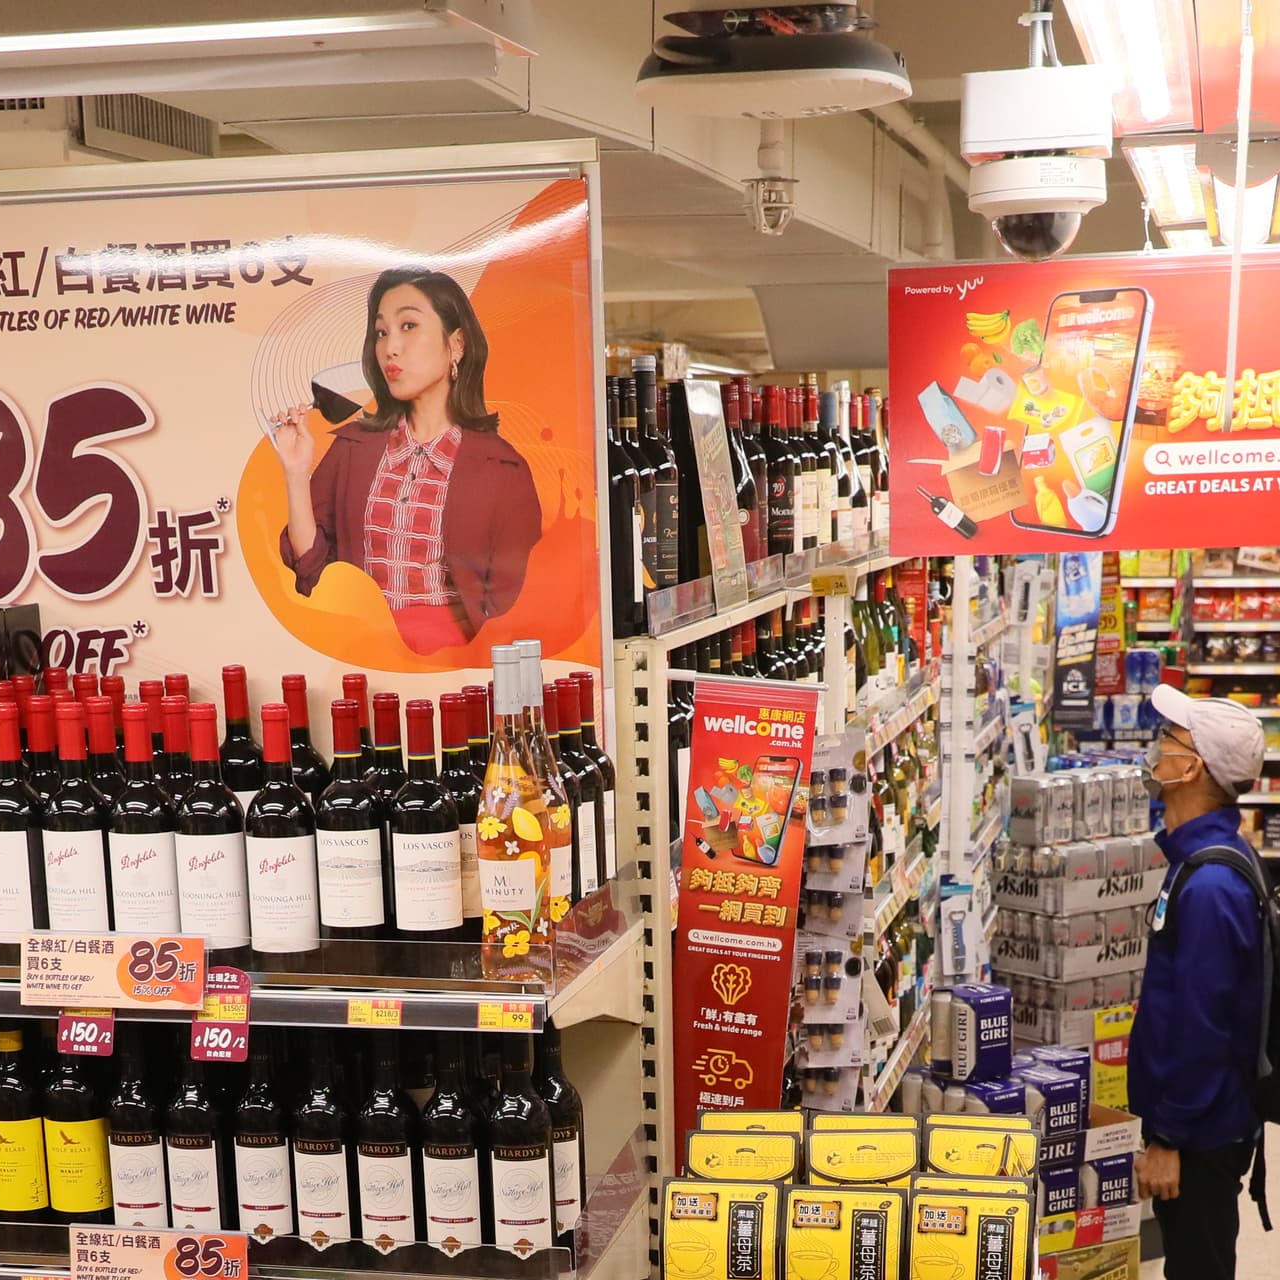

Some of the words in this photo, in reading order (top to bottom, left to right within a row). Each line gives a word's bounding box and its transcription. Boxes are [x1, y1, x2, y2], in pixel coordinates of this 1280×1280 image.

[905, 285, 939, 296] Powered
[941, 284, 953, 297] by
[44, 308, 69, 330] OF
[74, 304, 180, 328] RED/WHITE
[185, 302, 236, 324] WINE
[1145, 480, 1197, 494] GREAT
[1202, 479, 1250, 494] DEALS
[1253, 478, 1272, 492] AT
[704, 714, 804, 740] wellcome
[769, 739, 802, 749] .com.hk
[702, 933, 778, 950] wellcome.com.hk
[693, 1021, 714, 1032] Fresh
[721, 1026, 738, 1034] wide
[739, 1027, 763, 1037] range
[980, 1016, 1009, 1030] BLUE
[982, 1028, 1009, 1041] GIRL
[1050, 1102, 1077, 1117] BLUE
